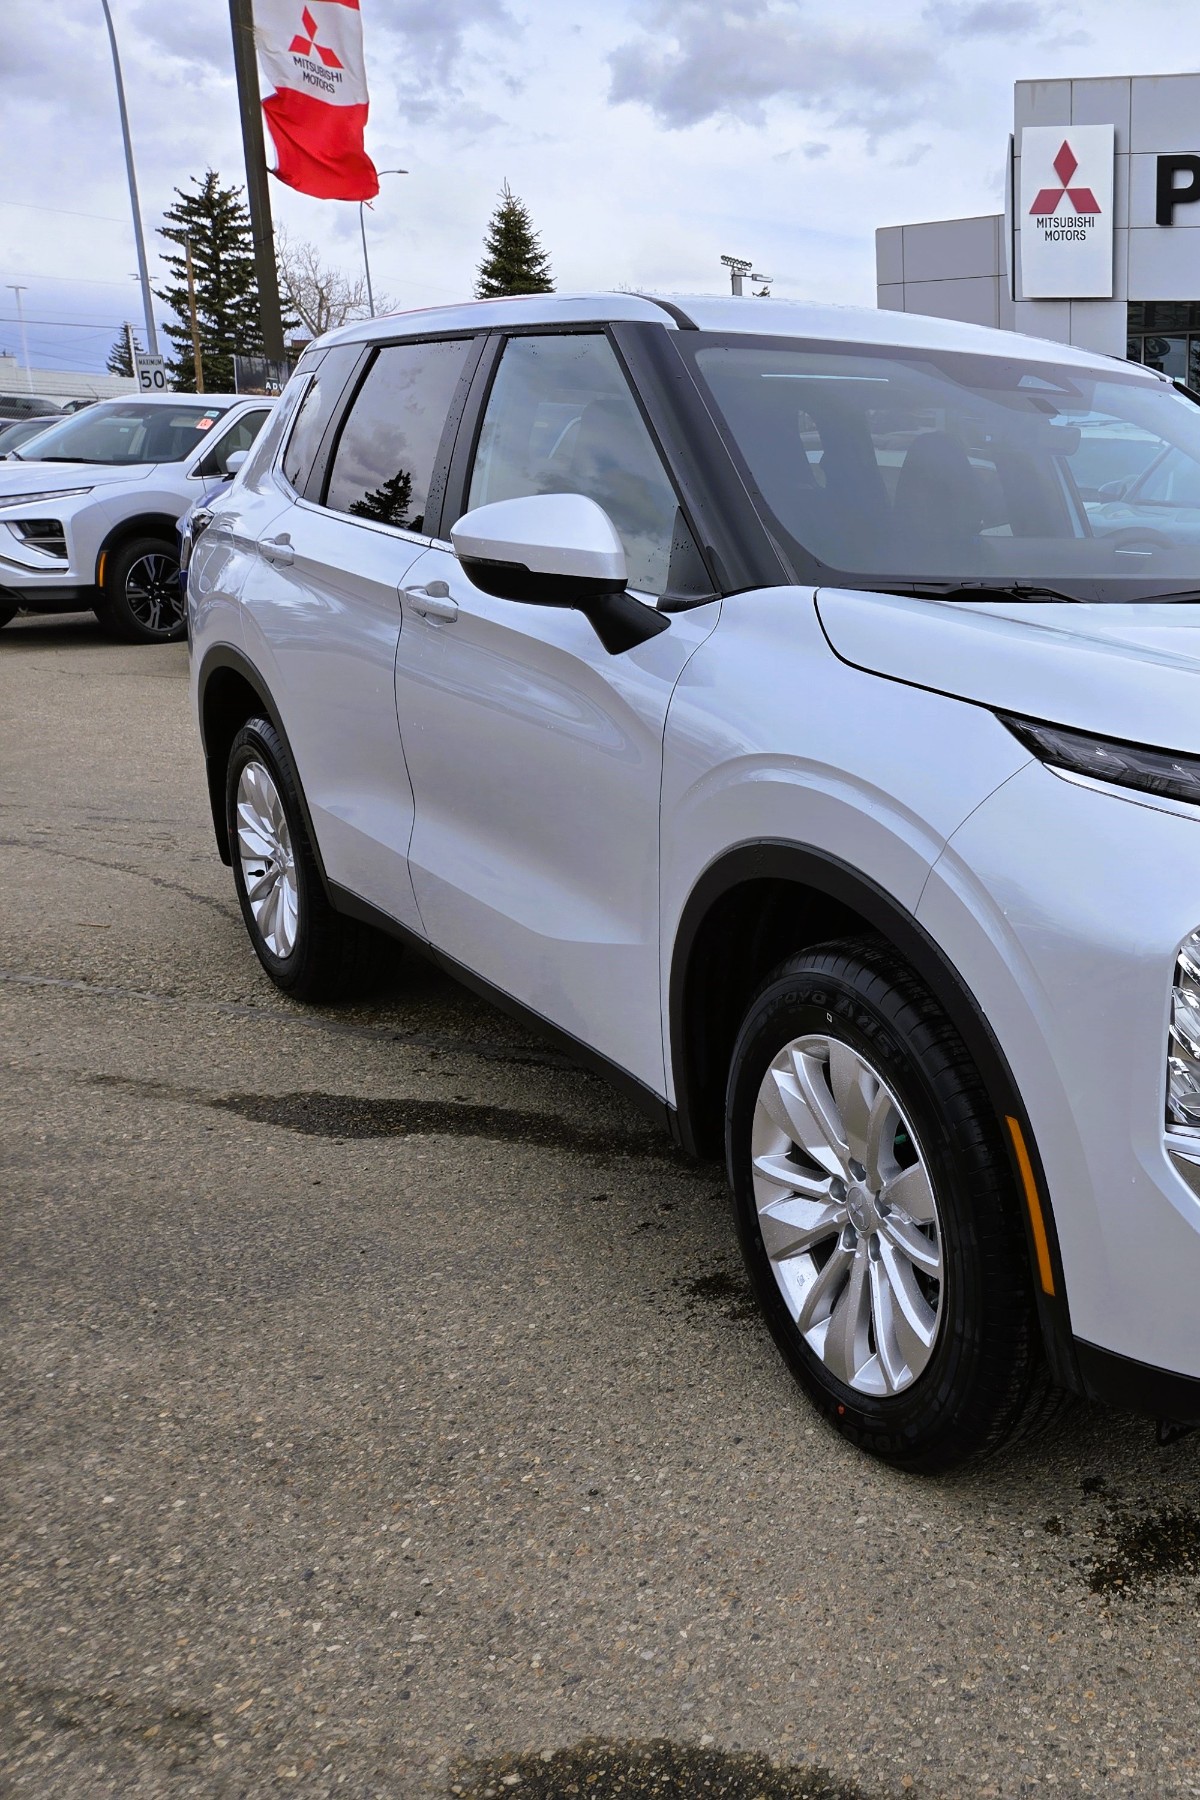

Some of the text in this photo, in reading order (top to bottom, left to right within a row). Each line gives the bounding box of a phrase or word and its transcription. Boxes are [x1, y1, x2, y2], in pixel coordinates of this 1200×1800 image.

[293, 56, 343, 83] MITSUBISHI
[302, 72, 336, 94] MOTORS
[1036, 216, 1095, 229] MITSUBISHI
[1044, 229, 1087, 242] MOTORS
[140, 370, 165, 388] 50
